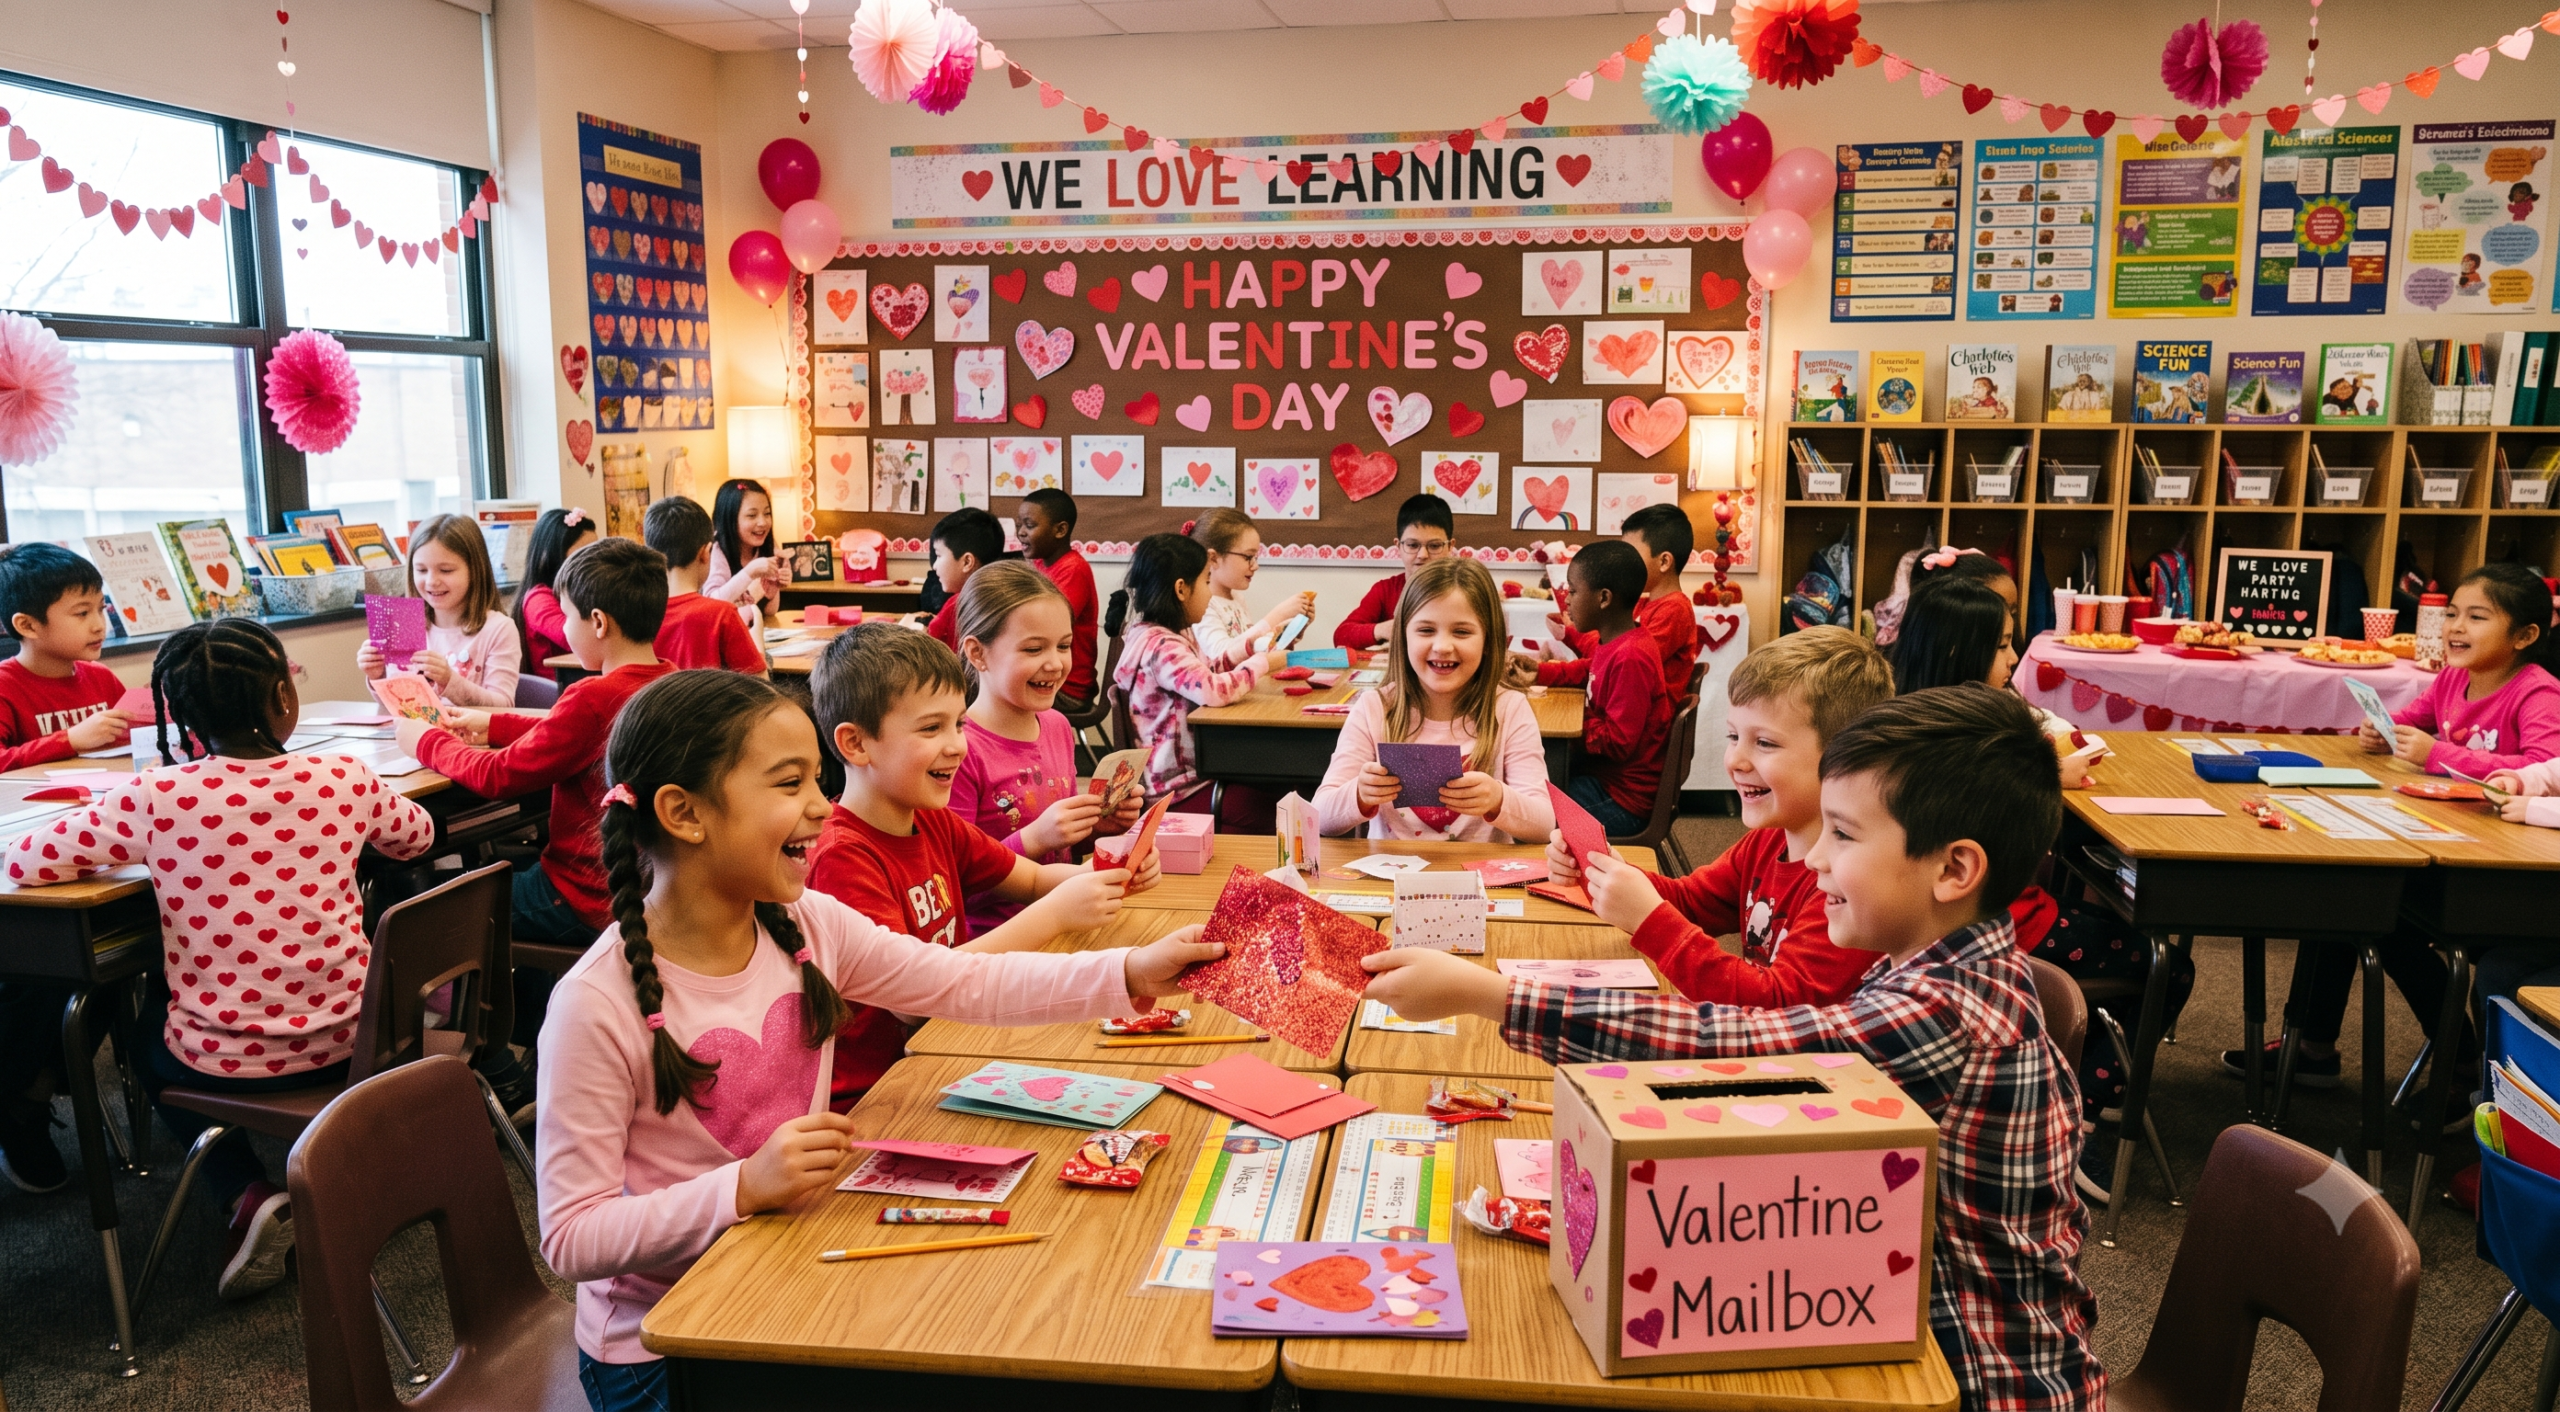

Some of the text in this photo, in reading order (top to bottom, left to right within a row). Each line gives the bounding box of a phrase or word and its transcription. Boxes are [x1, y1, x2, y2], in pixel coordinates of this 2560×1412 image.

[1001, 146, 1545, 210] WE LOVE LEARNING
[1183, 258, 1390, 309] HAPPY
[1095, 311, 1488, 370] VALENTINE'S
[1951, 348, 2014, 367] Charlotte's
[2143, 344, 2208, 358] SCIENCE
[1968, 361, 1996, 376] Web
[2158, 358, 2190, 371] FUN
[2233, 356, 2300, 369] Science Fun
[1232, 382, 1350, 431] DAY
[2238, 560, 2308, 573] WE LOVE
[2251, 574, 2295, 586] PARTY
[2240, 587, 2300, 600] HARTNG
[1646, 1175, 1883, 1249] Valentine
[1671, 1269, 1877, 1340] Mailbox
